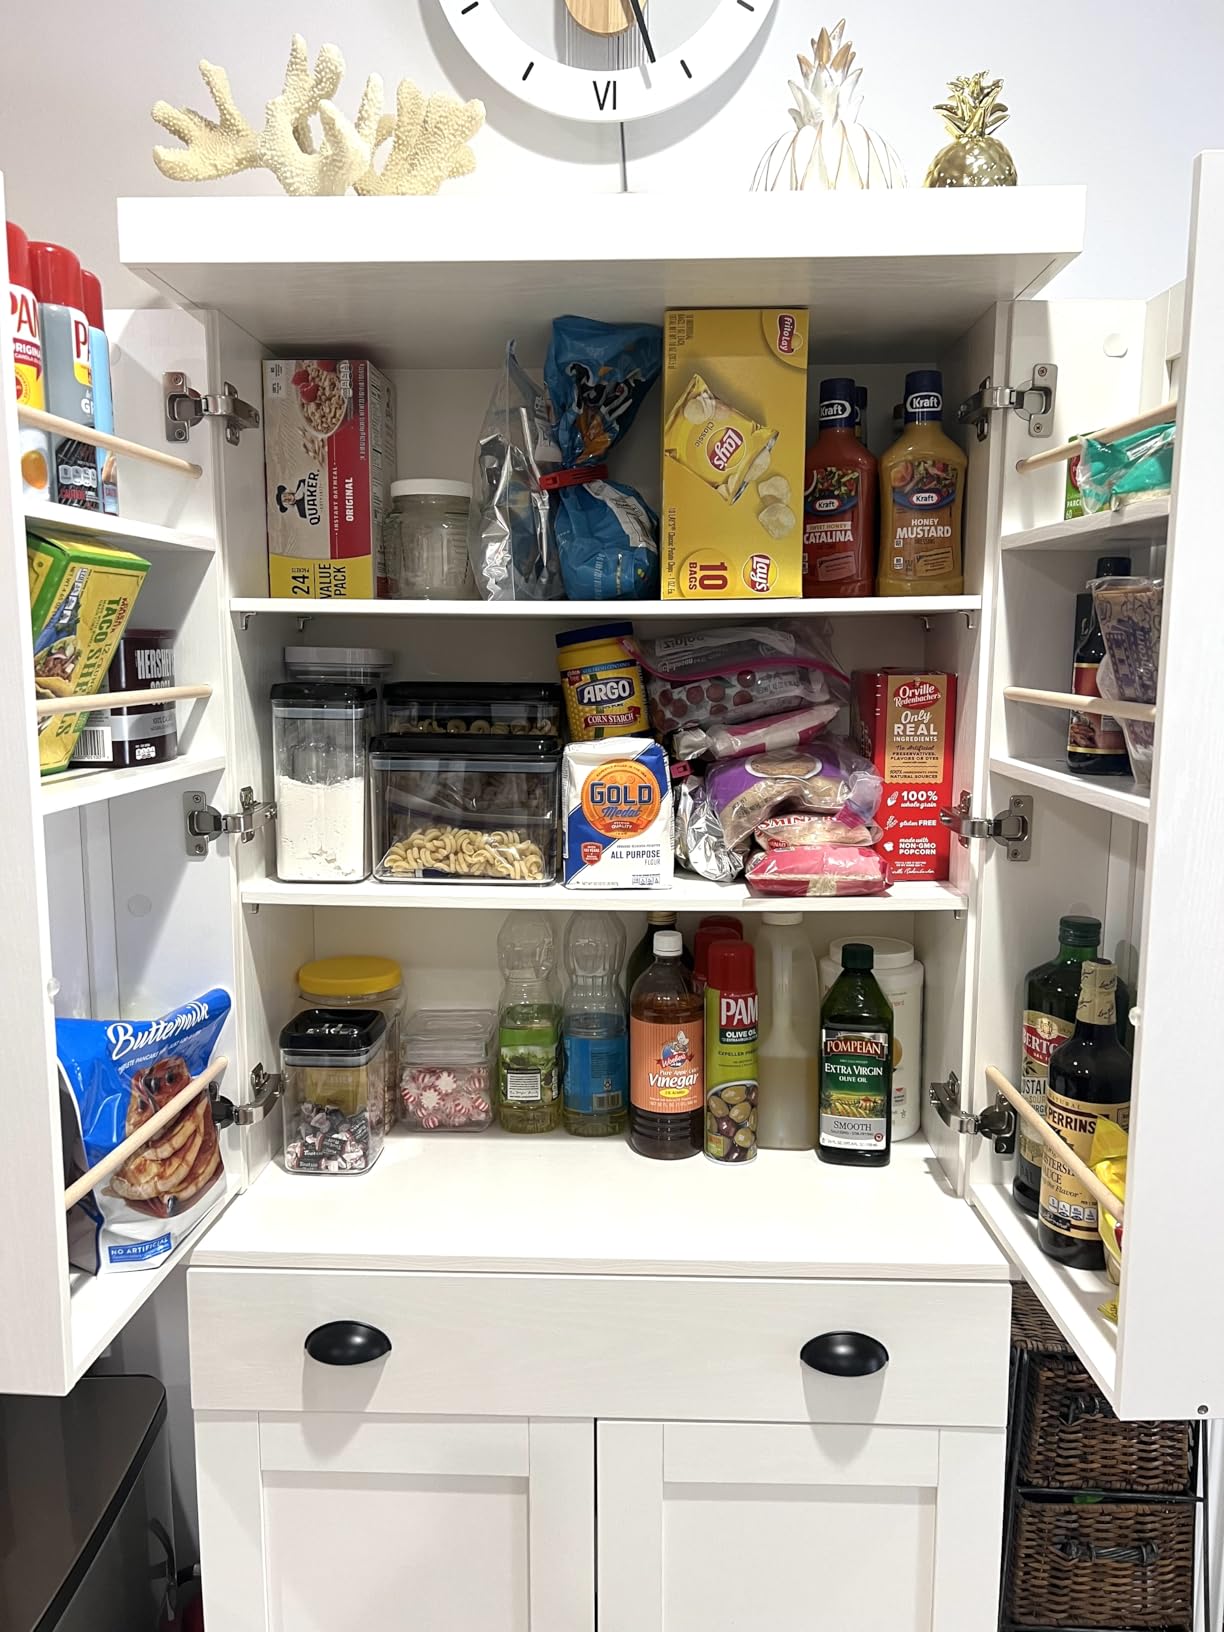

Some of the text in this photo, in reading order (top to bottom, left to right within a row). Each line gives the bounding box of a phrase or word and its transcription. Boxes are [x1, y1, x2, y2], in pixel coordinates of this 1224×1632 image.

[592, 81, 617, 110] VI
[821, 403, 843, 418] Kraft
[913, 397, 938, 409] Kraft
[345, 477, 354, 522] ORIGINAL
[818, 500, 835, 510] Kraft
[916, 494, 935, 503] Kraft
[911, 518, 939, 527] HONEY
[804, 529, 854, 544] CATALINA
[896, 526, 952, 539] MUSTARD
[318, 563, 332, 599] VALUE
[333, 566, 346, 596] PACK
[689, 562, 698, 590] BAGS
[699, 562, 728, 591] 10
[291, 574, 310, 596] 24
[94, 597, 121, 643] TACO
[583, 680, 630, 704] ARGO
[899, 683, 935, 698] Orville
[894, 692, 941, 708] Redenbacher's
[587, 712, 634, 725] CORN STARCH
[901, 709, 932, 724] Only
[894, 723, 938, 735] REAL
[590, 781, 654, 805] GOLD
[901, 790, 938, 801] 100%
[601, 806, 642, 820] Medal
[611, 849, 661, 859] ALL PURPOSE
[721, 994, 759, 1026] PAM
[726, 1030, 748, 1038] OLIVE
[827, 1040, 881, 1054] POMPEIAN
[825, 1062, 883, 1076] EXTRA VIRGIN
[648, 1072, 699, 1089] Vinegar
[833, 1120, 872, 1131] SMOOTH
[1048, 1107, 1097, 1135] PERRINS
[111, 1237, 169, 1256] NO ARTIFICIAL
